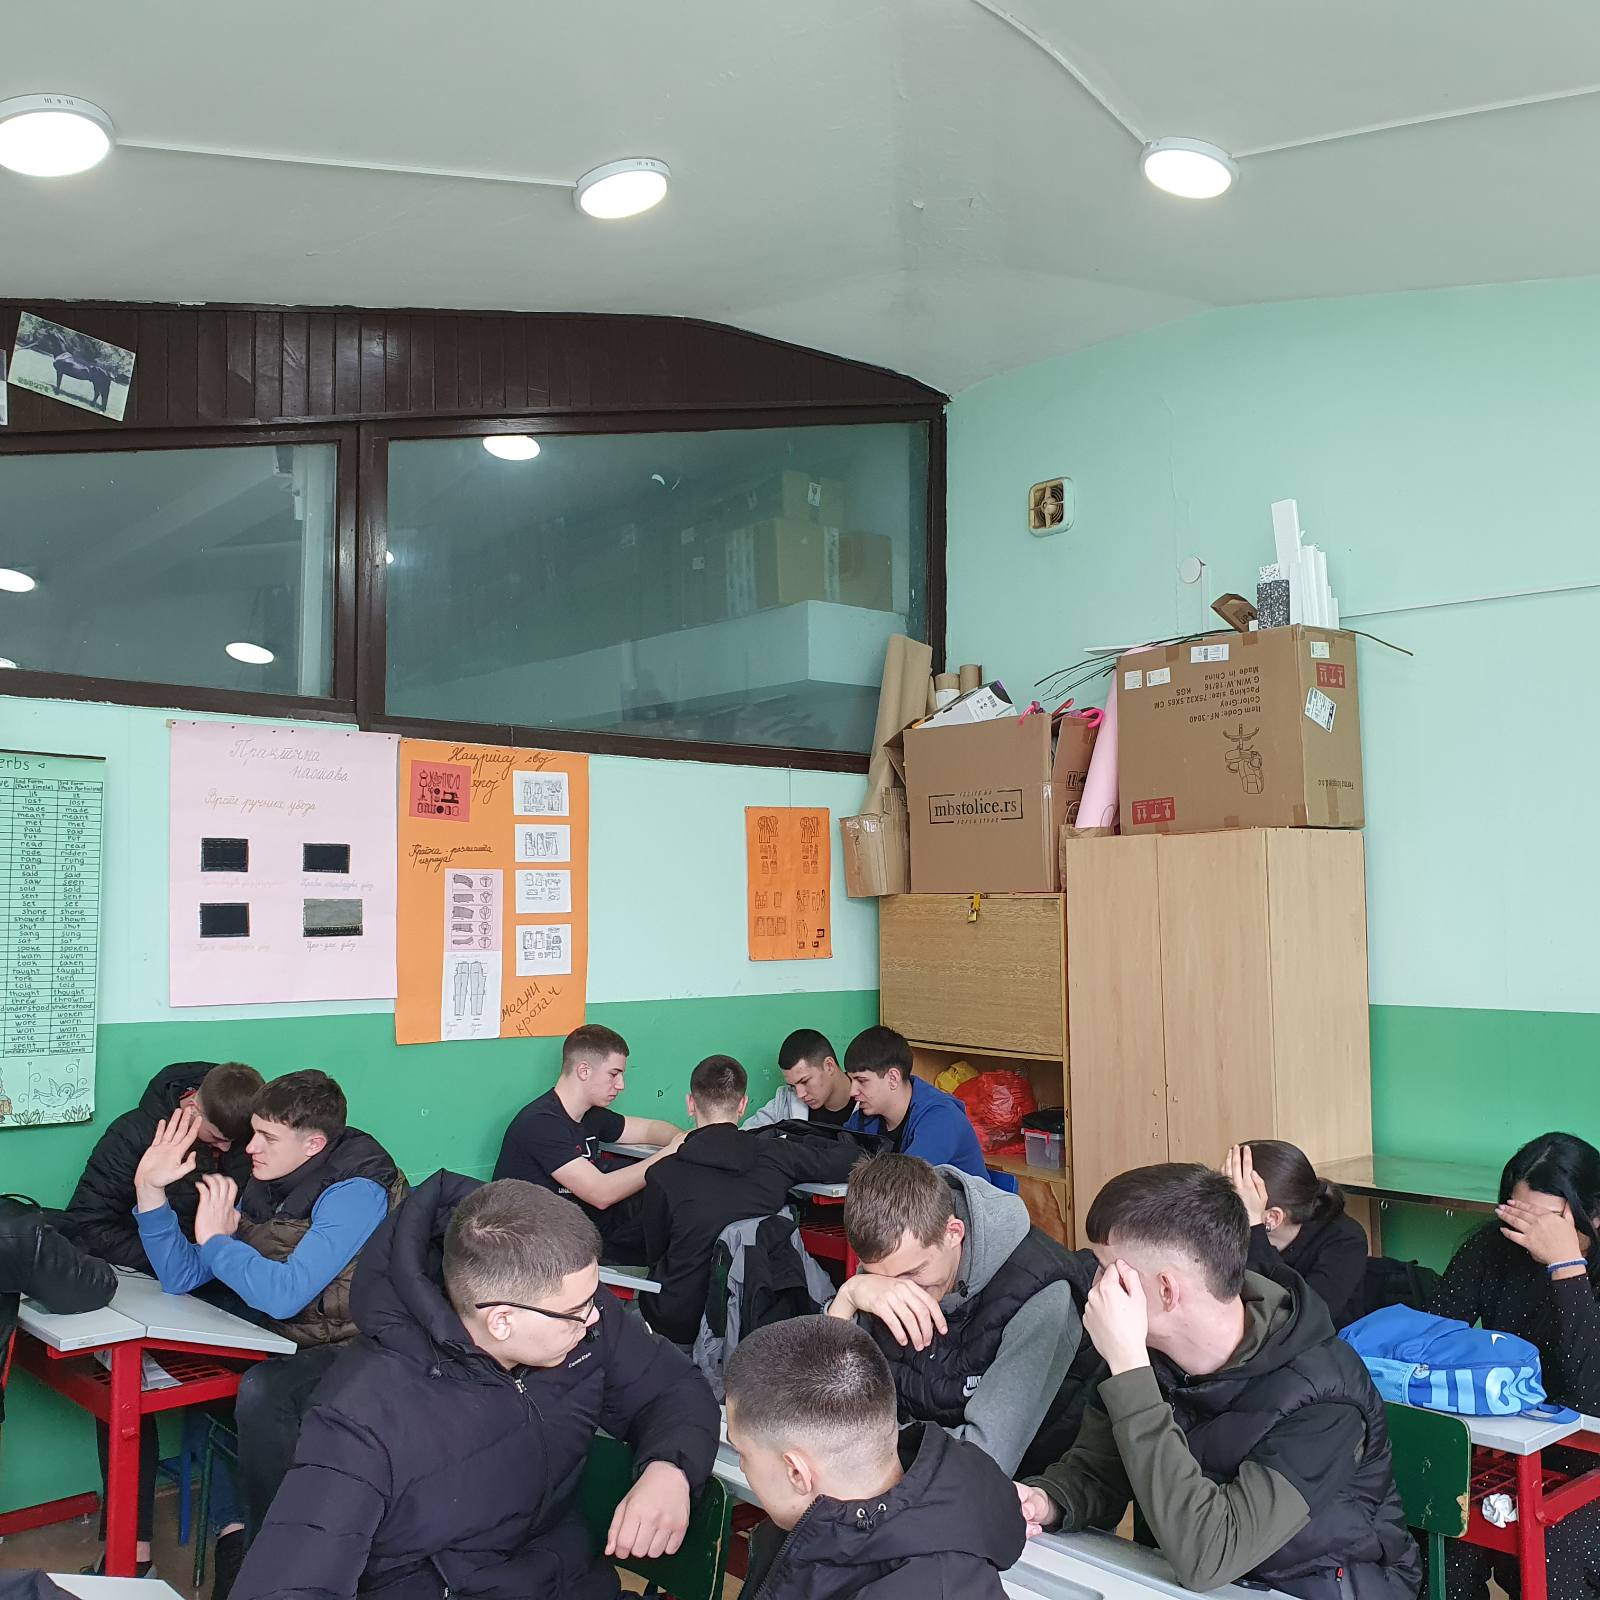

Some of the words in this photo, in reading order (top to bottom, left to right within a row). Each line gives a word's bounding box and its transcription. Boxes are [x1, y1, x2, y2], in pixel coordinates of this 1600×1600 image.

[1240, 666, 1259, 674] Made
[1205, 672, 1225, 680] China
[1176, 687, 1191, 696] KGS
[1230, 686, 1260, 696] Packing
[1154, 701, 1164, 709] CM
[0, 757, 29, 770] erbs
[934, 798, 1016, 817] mbstolice.rs
